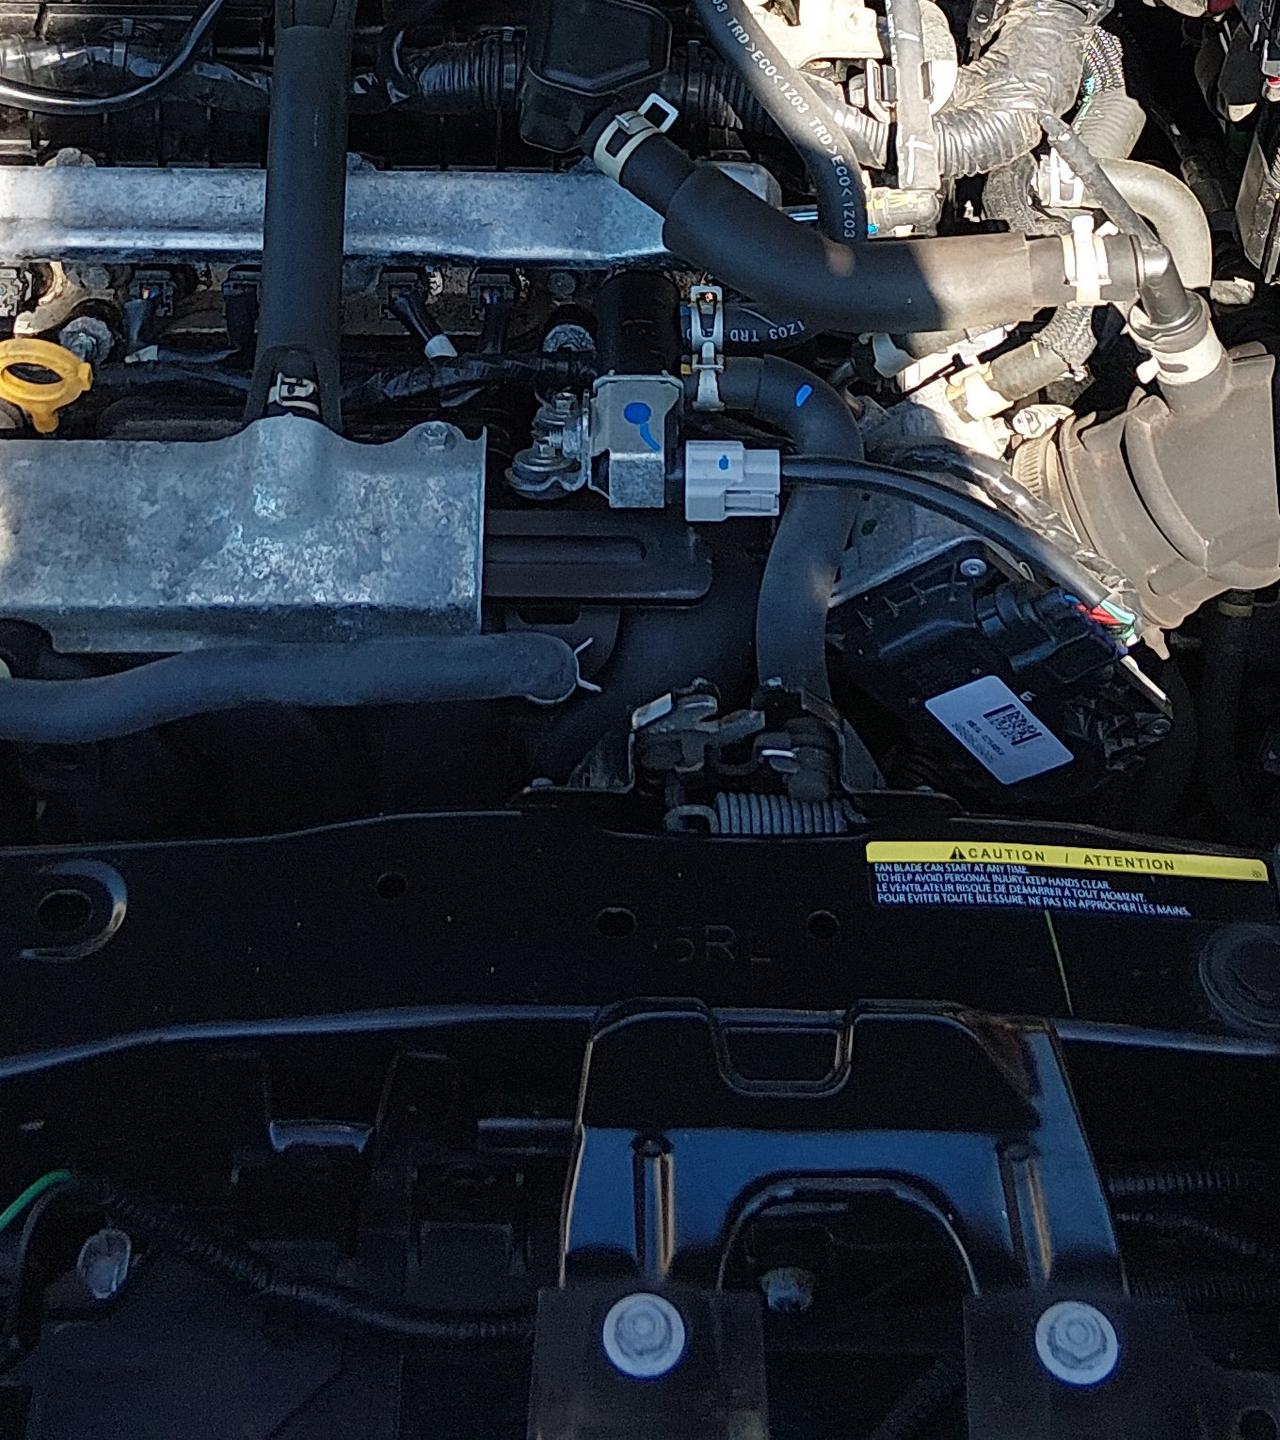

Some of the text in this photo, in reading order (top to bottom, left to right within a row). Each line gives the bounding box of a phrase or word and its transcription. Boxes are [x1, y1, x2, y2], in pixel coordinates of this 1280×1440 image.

[968, 848, 1045, 862] CAUTION
[1083, 854, 1175, 870] ATTENTION
[874, 863, 892, 872] FAN
[894, 863, 922, 872] BLADE
[924, 864, 944, 873] CAN
[945, 863, 971, 873] START
[974, 864, 984, 873] AT
[986, 864, 1005, 873] ANY
[876, 873, 889, 882] TO
[890, 873, 912, 882] HELP
[914, 873, 943, 882] AVOID
[944, 873, 991, 883] PERSONAL
[1026, 876, 1047, 885] KEEP
[1048, 878, 1080, 888] HANDS
[877, 883, 888, 892] LE
[889, 883, 954, 893] VENTILATEUR
[956, 884, 992, 895] RISQUE
[994, 884, 1007, 893] DE
[1073, 888, 1098, 898] TOUT
[878, 893, 906, 902] POUR
[943, 892, 974, 903] TOUTE
[1028, 896, 1041, 905] NE
[1044, 897, 1062, 906] PAS
[1063, 898, 1077, 907] EN
[1079, 899, 1137, 911] APPROCHER
[1138, 903, 1155, 913] LES
